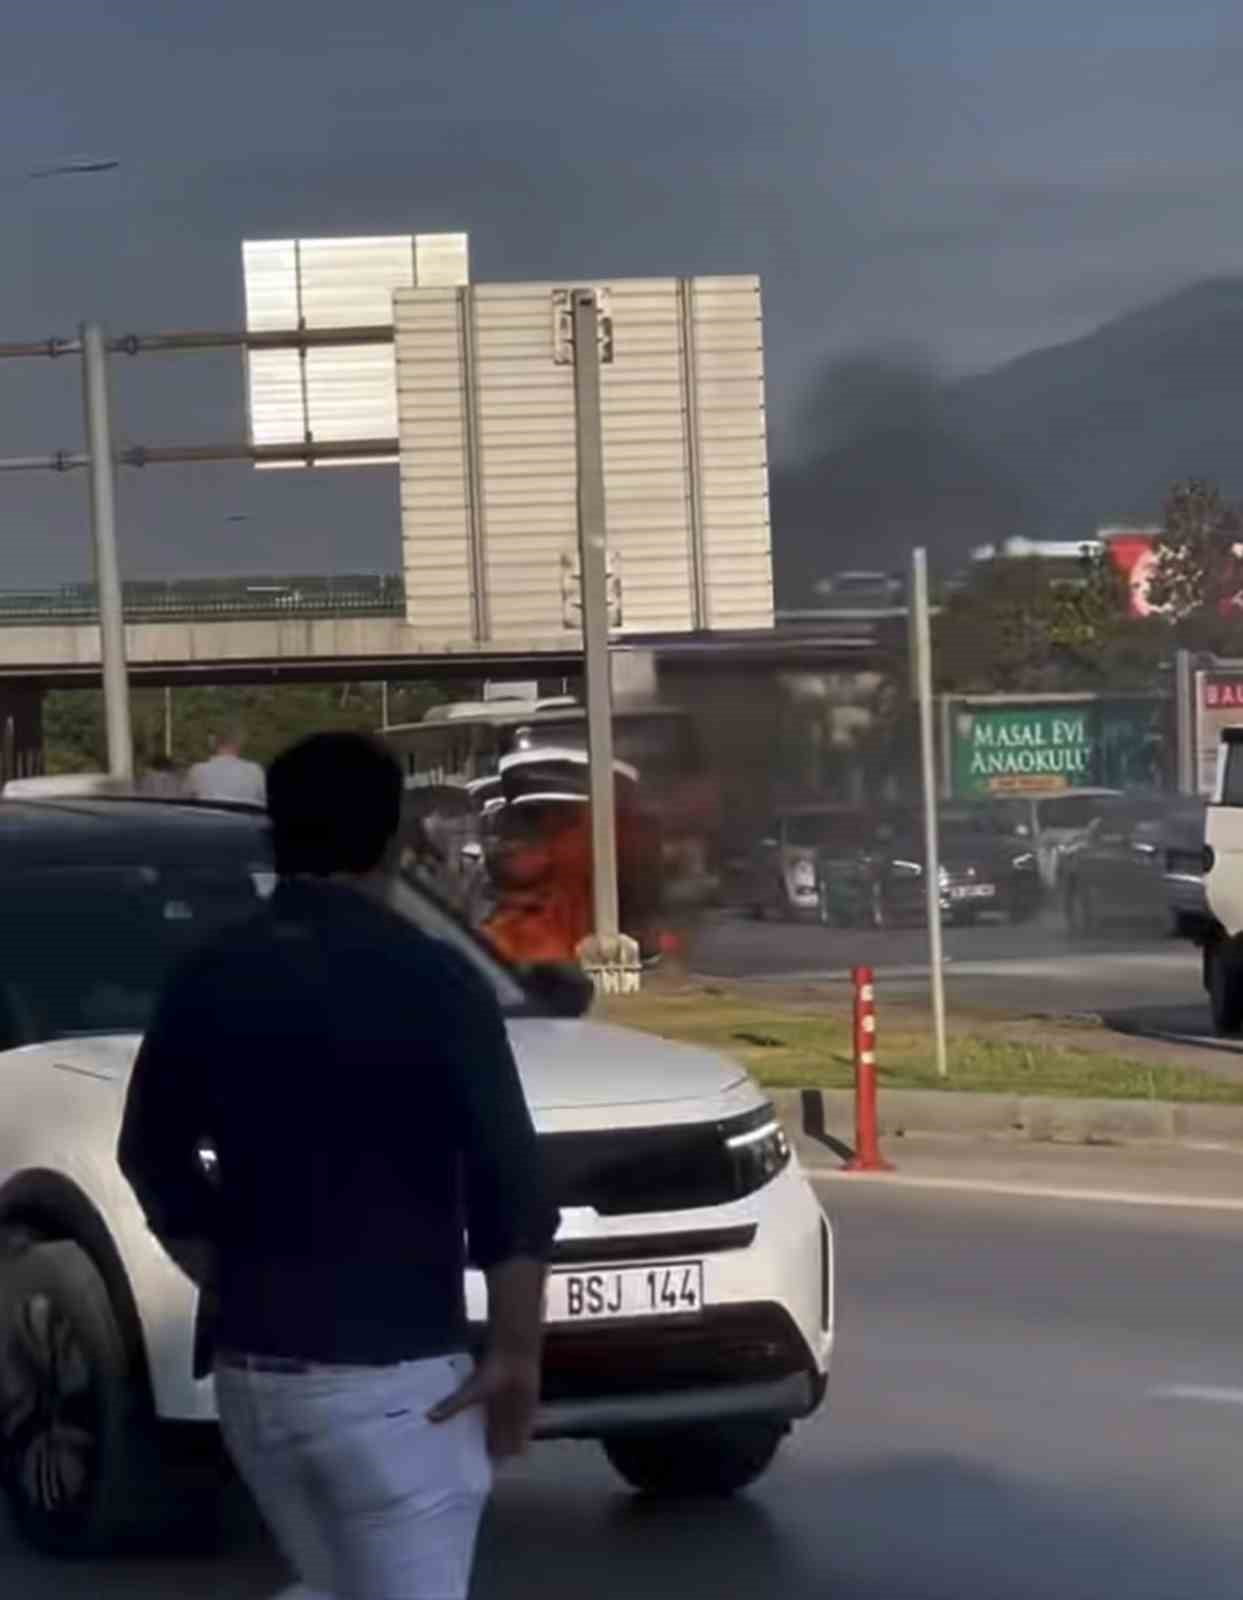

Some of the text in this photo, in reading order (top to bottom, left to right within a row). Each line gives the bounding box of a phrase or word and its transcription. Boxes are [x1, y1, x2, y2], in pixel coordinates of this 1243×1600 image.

[974, 721, 1046, 747] MASAL
[567, 1269, 696, 1314] BSJ 144
